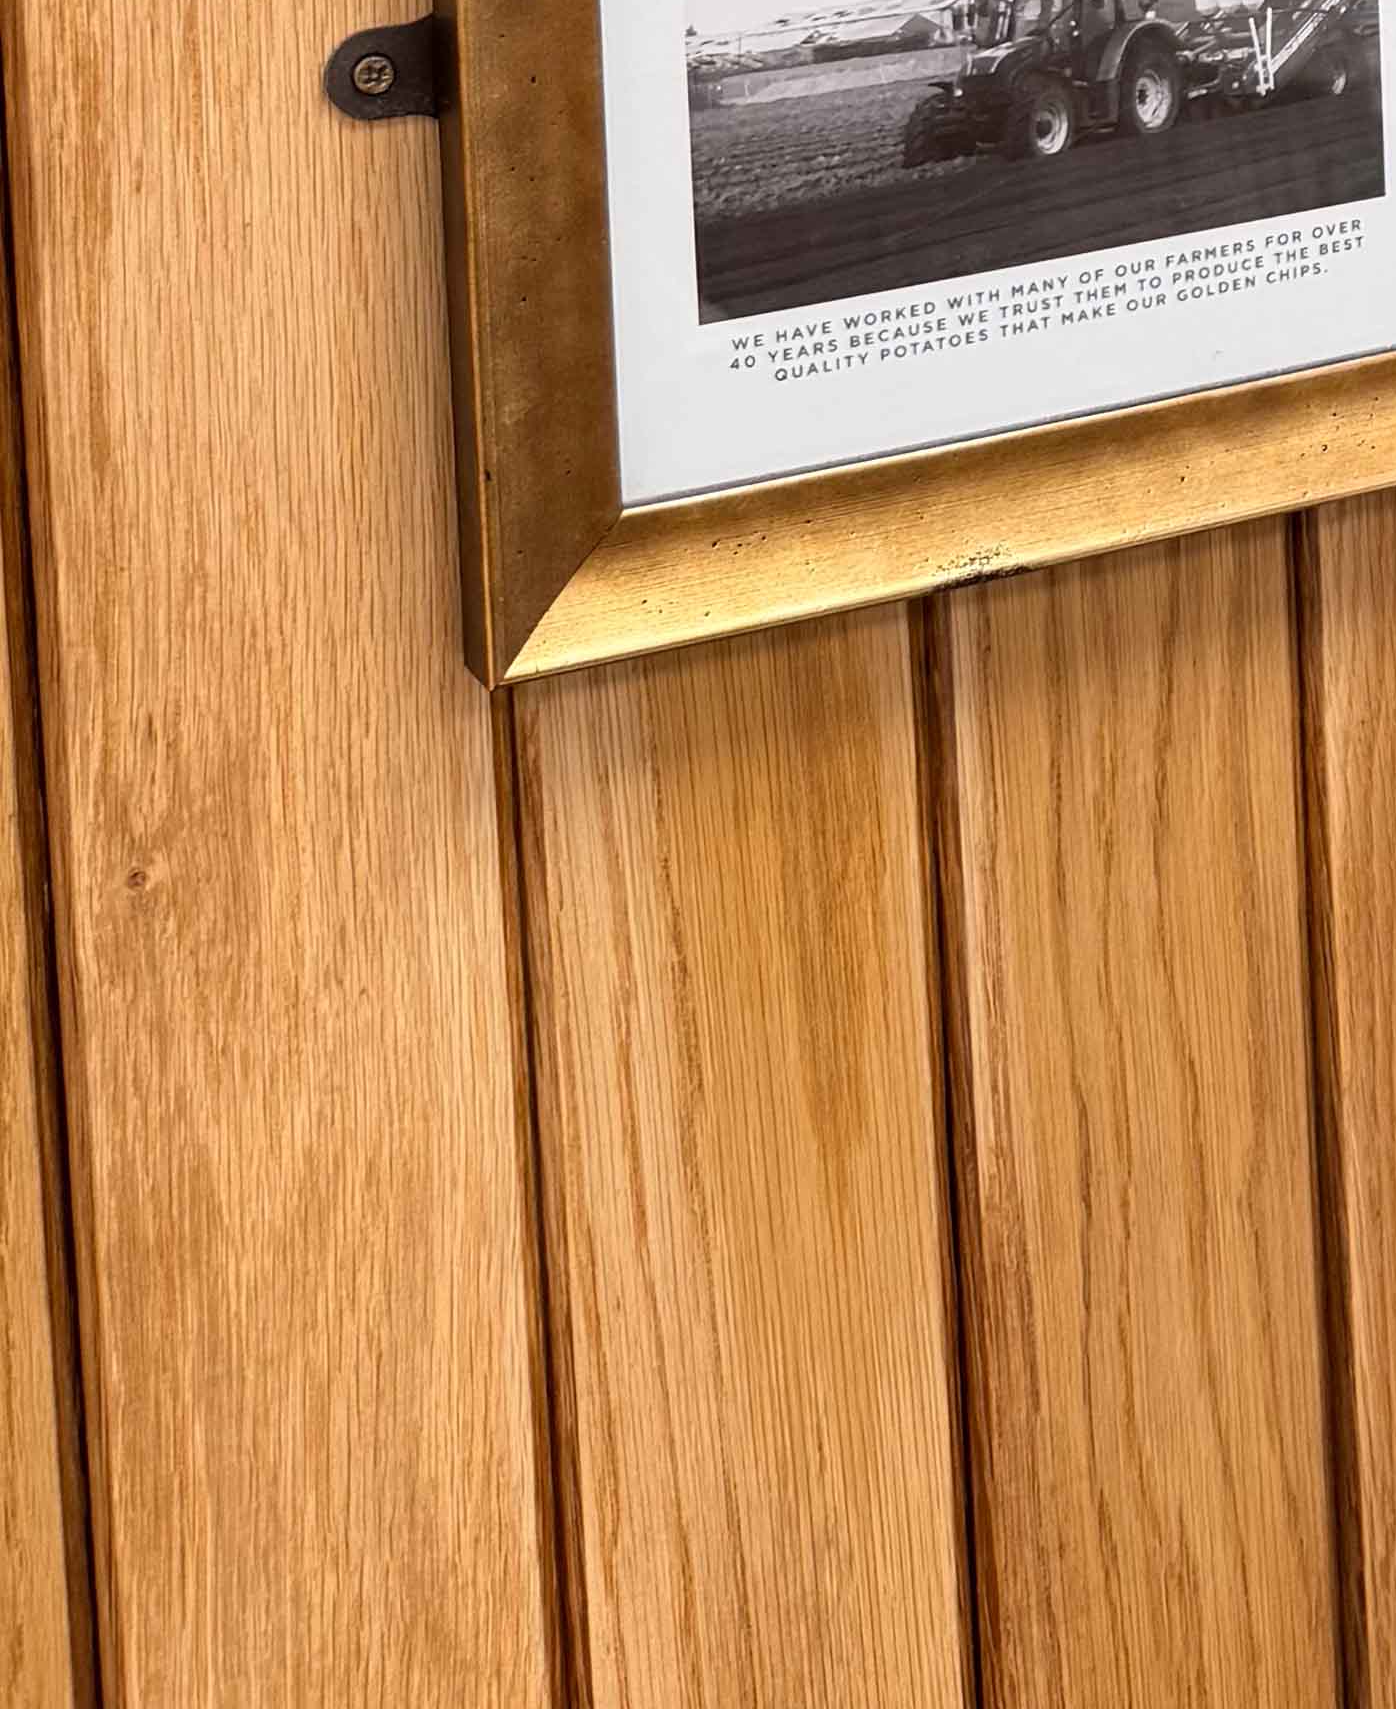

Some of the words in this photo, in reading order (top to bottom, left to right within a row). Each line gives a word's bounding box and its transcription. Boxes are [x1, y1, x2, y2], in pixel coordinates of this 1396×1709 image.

[730, 355, 756, 370] 40
[768, 339, 838, 364] YEARS
[850, 317, 947, 349] BECAUSE
[957, 309, 989, 327] WE
[1000, 295, 1065, 319] TRUST
[1074, 283, 1127, 305] THEM
[1137, 276, 1162, 292] TO
[1173, 255, 1265, 286] PRODUCE
[1274, 246, 1310, 265] THE
[1319, 235, 1365, 256] BEST
[732, 333, 765, 351] WE
[776, 320, 832, 344] HAVE
[843, 301, 936, 330] WORKED
[947, 288, 1000, 310] WITH
[1011, 276, 1068, 298] MANY
[1079, 268, 1105, 284] OF
[1115, 259, 1156, 278] OUR
[1165, 240, 1256, 268] FARMERS
[1265, 231, 1302, 248] FOR
[1312, 219, 1362, 239] OVER
[775, 352, 868, 381] QUALITY
[880, 328, 989, 361] POTATOES
[1000, 316, 1050, 338] THAT
[1062, 303, 1116, 326] MAKE
[1126, 293, 1166, 312] OUR
[1177, 276, 1256, 302] GOLDEN
[1266, 262, 1329, 284] CHIPS.
